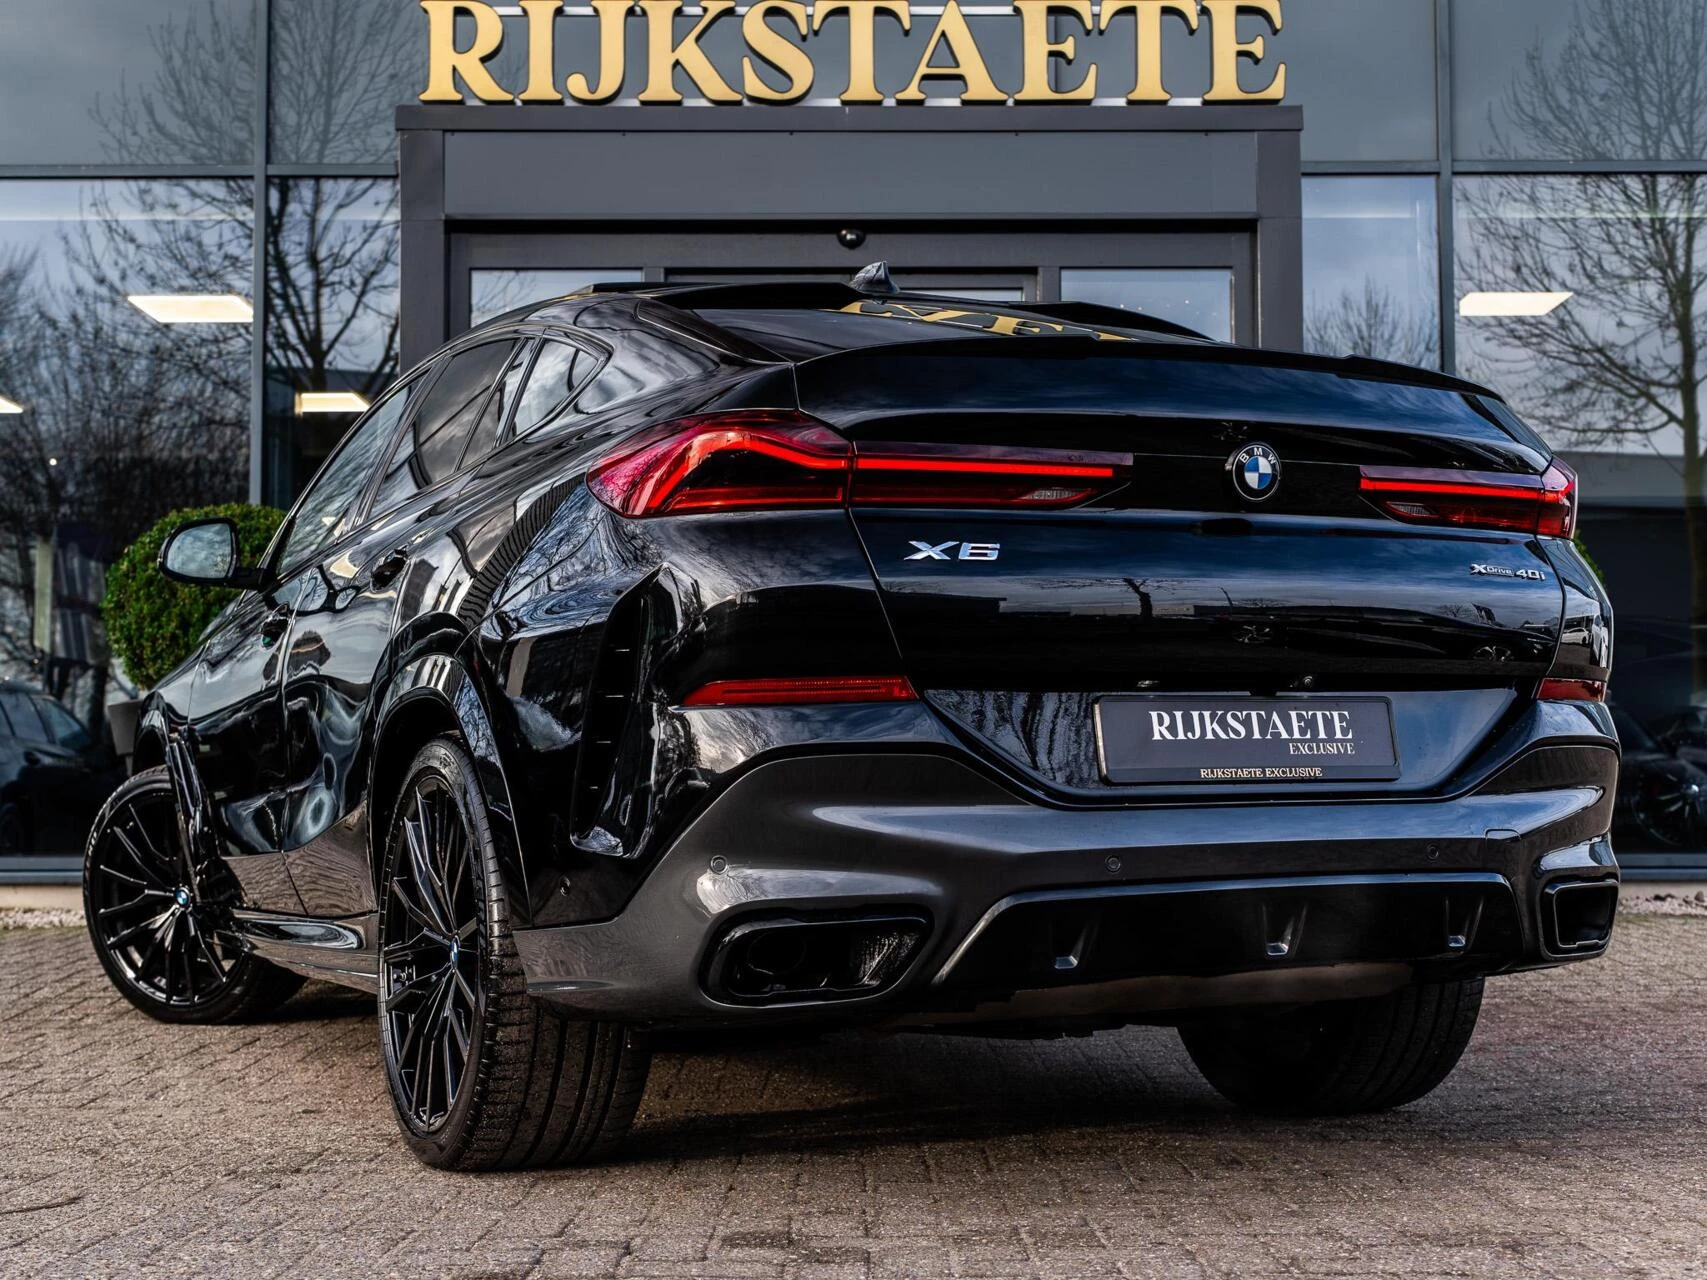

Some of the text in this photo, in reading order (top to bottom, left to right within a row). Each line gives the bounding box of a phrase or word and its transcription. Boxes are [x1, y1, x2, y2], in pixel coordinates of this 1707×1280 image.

[419, 0, 1287, 106] RIJKSTAETE
[1239, 447, 1277, 465] BMW
[904, 540, 1001, 561] X6
[1149, 710, 1353, 741] RIJKSTAETE
[1289, 742, 1355, 756] EXCLUSIVE
[1200, 767, 1323, 779] RIJKSTAETE EXCLUSIVE
